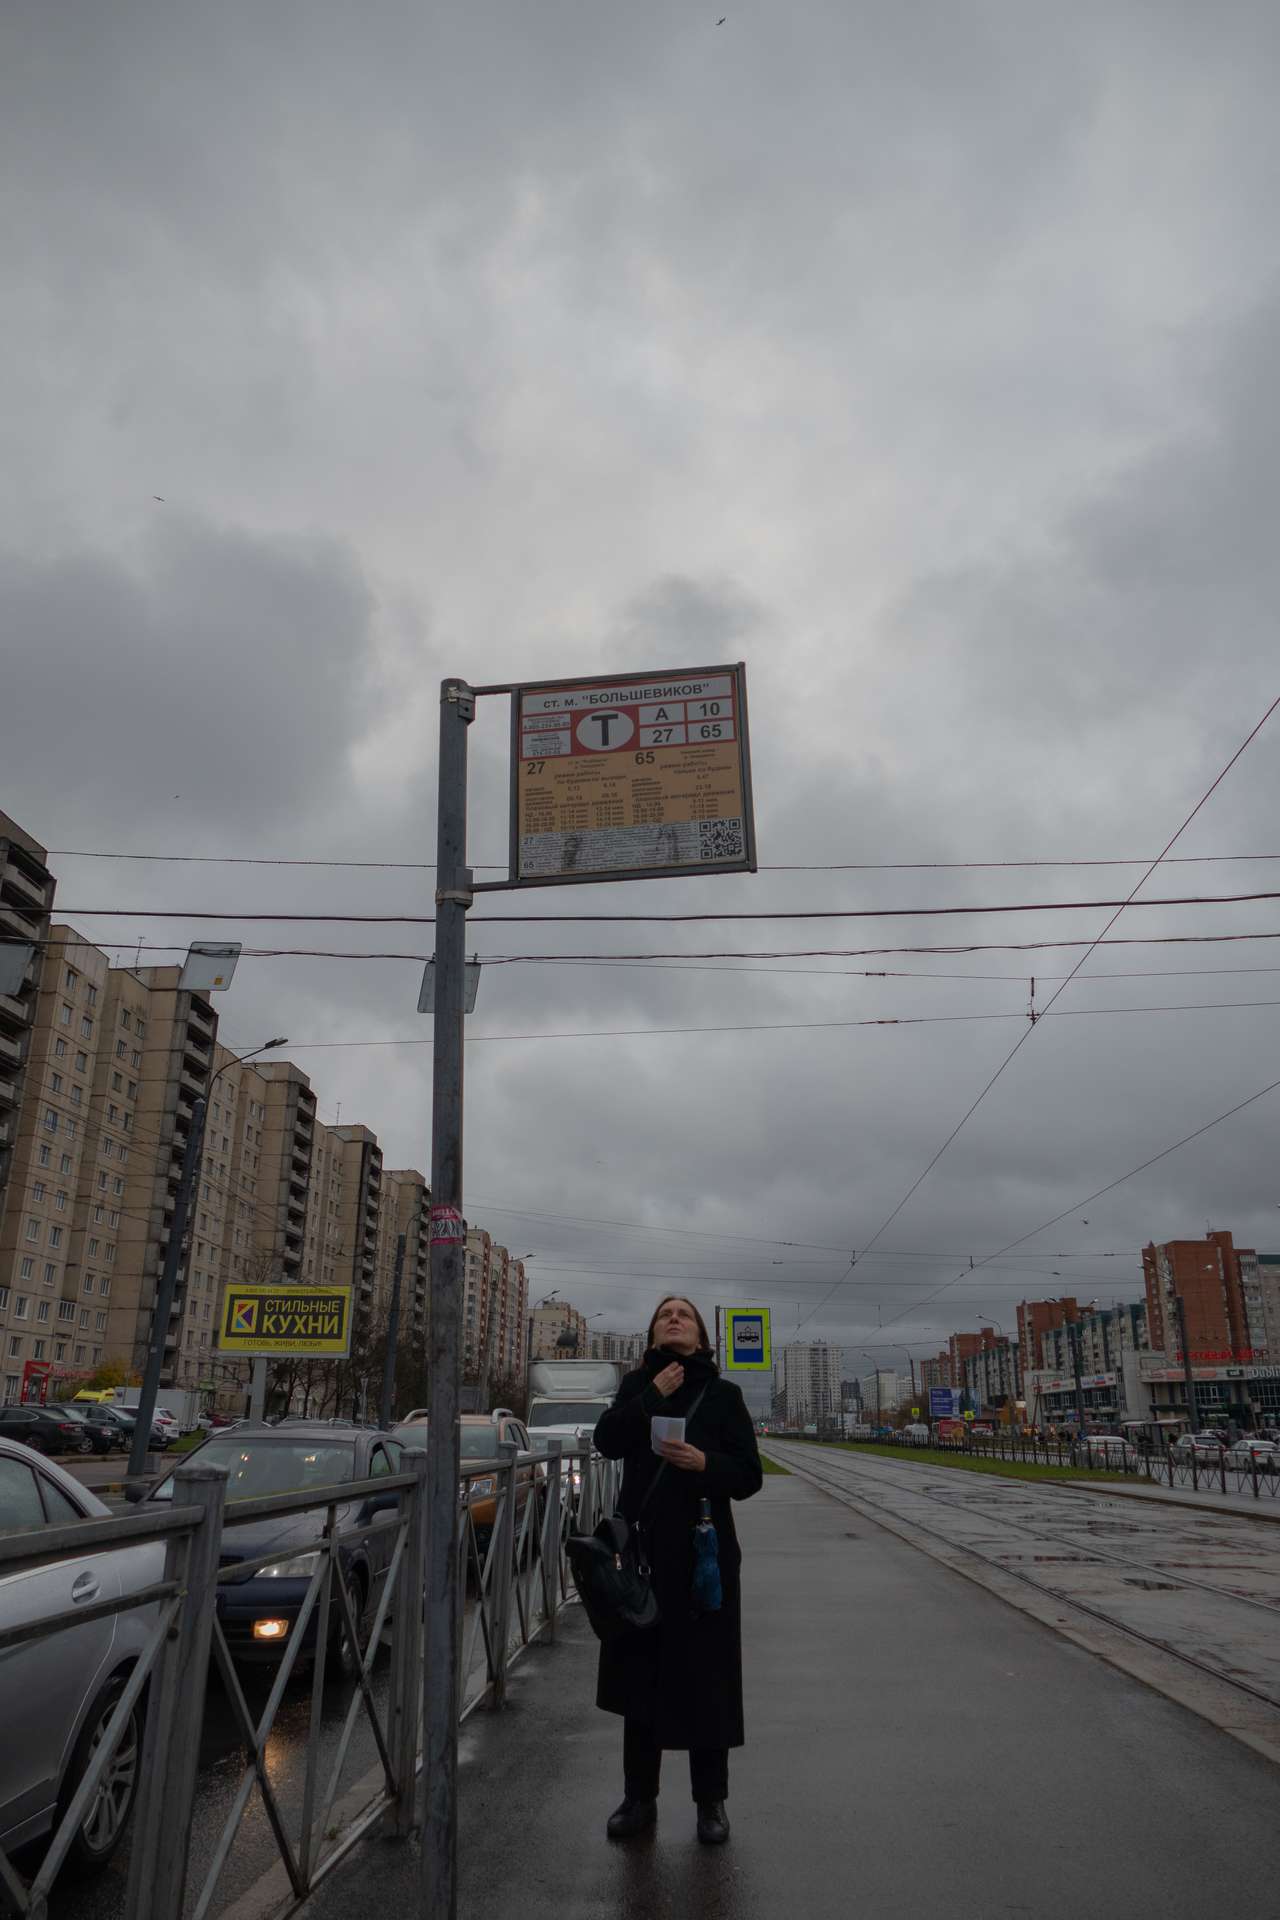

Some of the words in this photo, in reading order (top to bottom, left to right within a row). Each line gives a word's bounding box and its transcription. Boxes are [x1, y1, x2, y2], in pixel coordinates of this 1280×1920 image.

[699, 702, 720, 717] 10
[652, 728, 673, 744] 27
[700, 724, 722, 739] 65
[634, 751, 655, 766] 65
[527, 761, 546, 775] 27
[264, 1299, 341, 1313] СТИЛЬНЫЕ
[261, 1314, 340, 1335] КУХНИ
